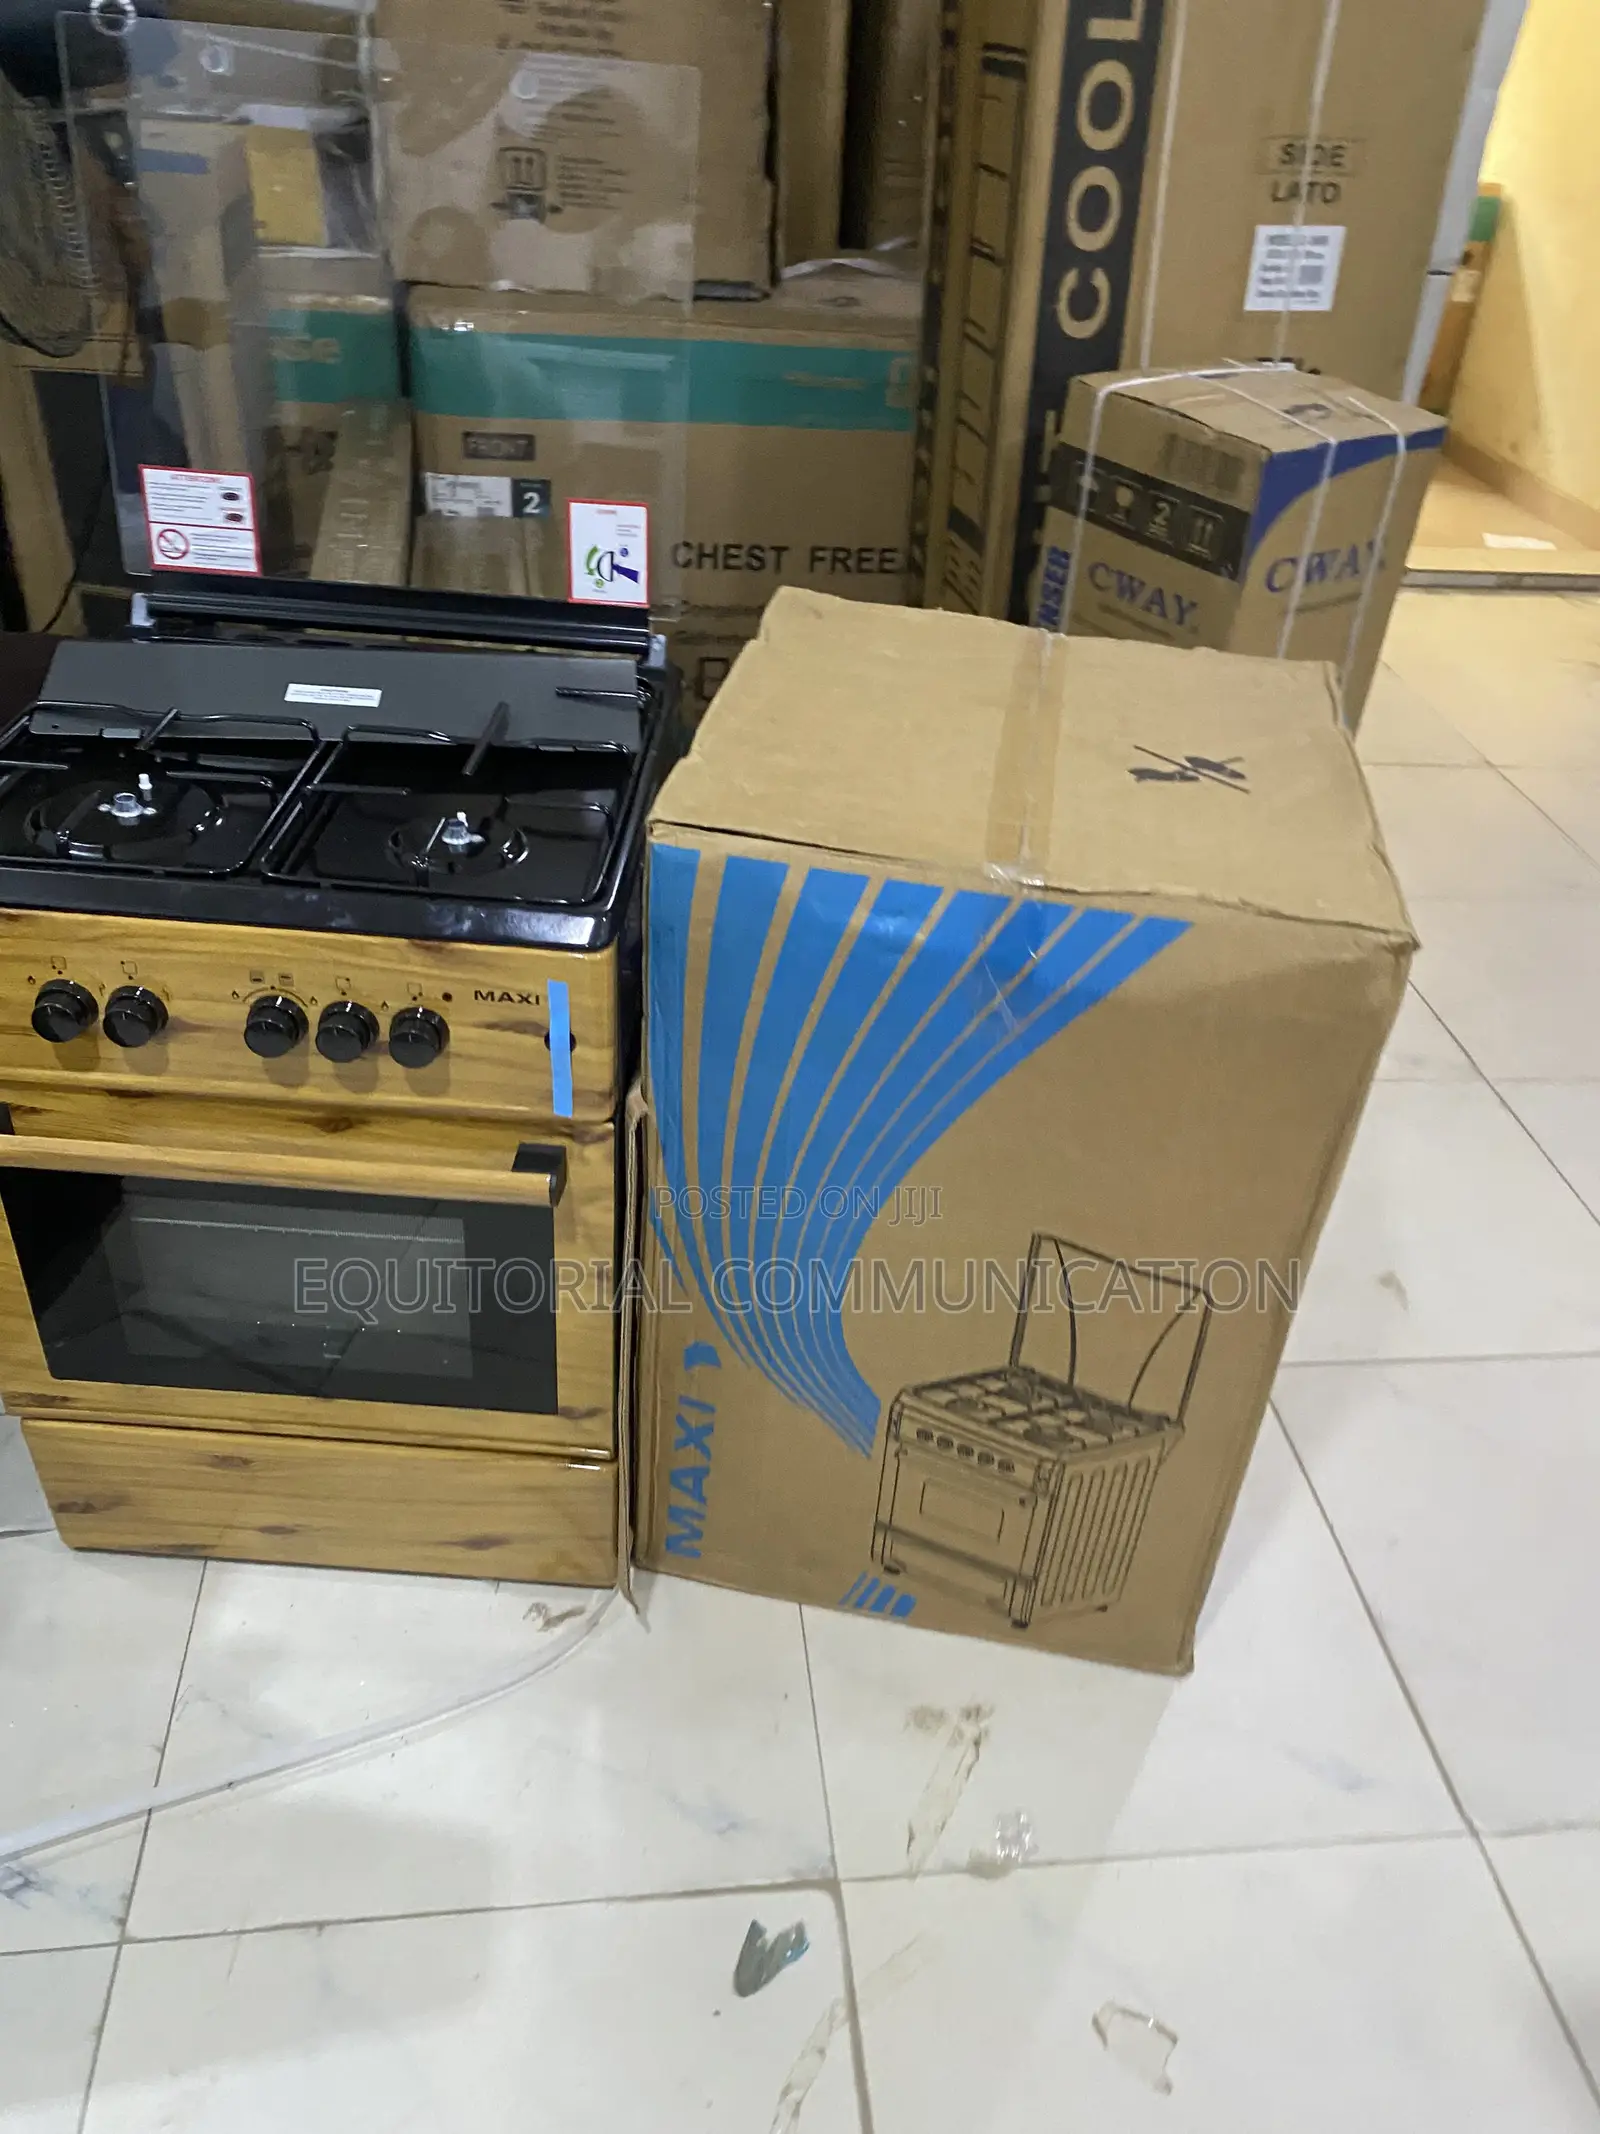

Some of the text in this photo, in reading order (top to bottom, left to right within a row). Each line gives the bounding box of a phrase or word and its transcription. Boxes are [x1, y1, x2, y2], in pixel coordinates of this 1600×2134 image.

[523, 491, 541, 514] 2
[671, 540, 899, 575] CHEST FREE
[1087, 561, 1198, 626] CWAY
[473, 989, 540, 1006] MAXI
[664, 1395, 717, 1559] MAXI
